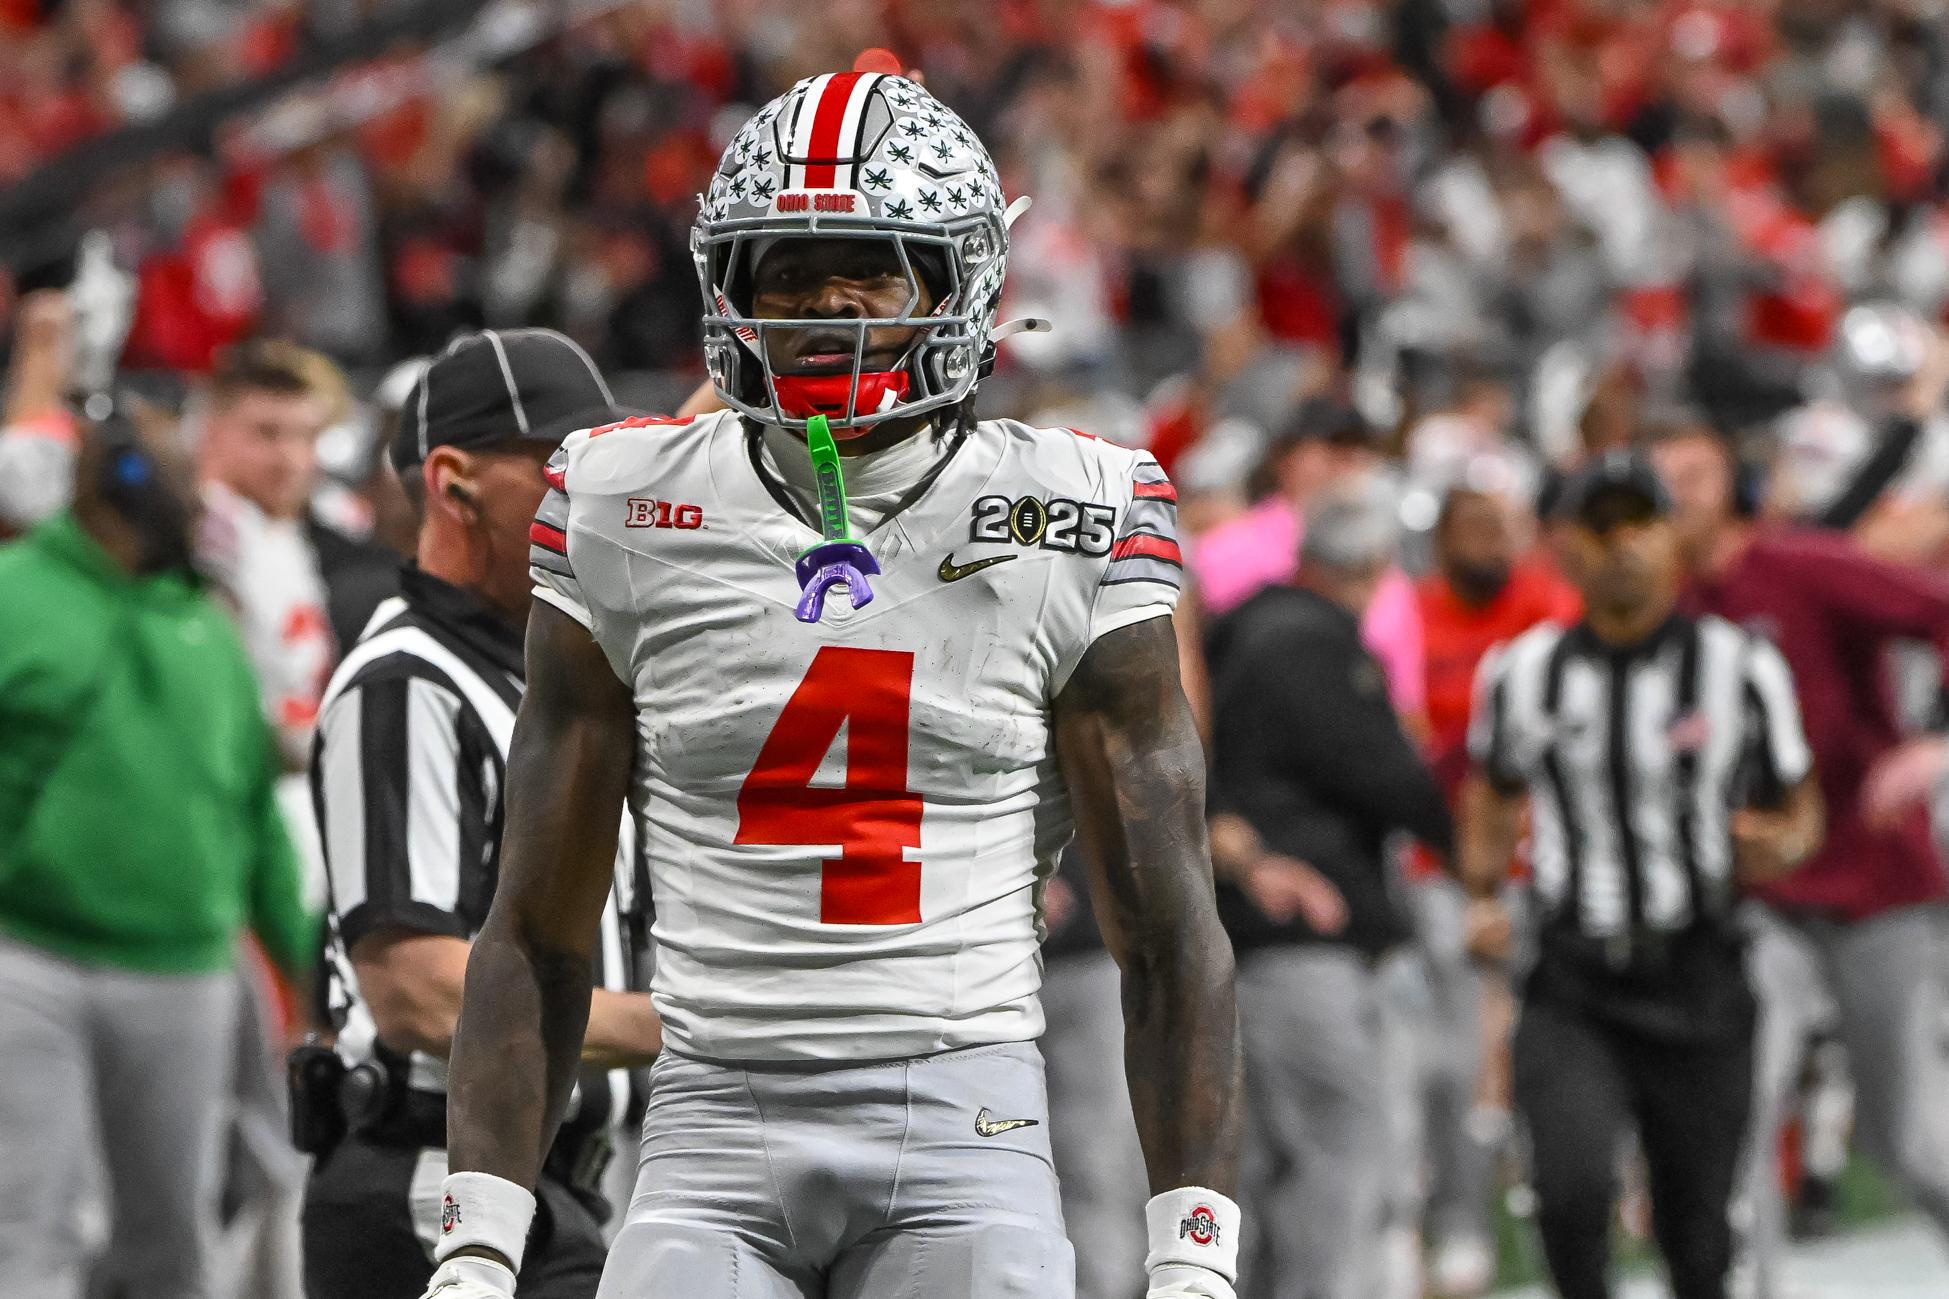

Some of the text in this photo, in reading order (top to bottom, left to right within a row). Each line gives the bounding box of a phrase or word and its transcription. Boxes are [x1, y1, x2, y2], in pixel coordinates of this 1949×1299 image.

[777, 194, 856, 213] OHIO STATE
[969, 495, 1116, 558] 2025
[733, 645, 924, 924] 4
